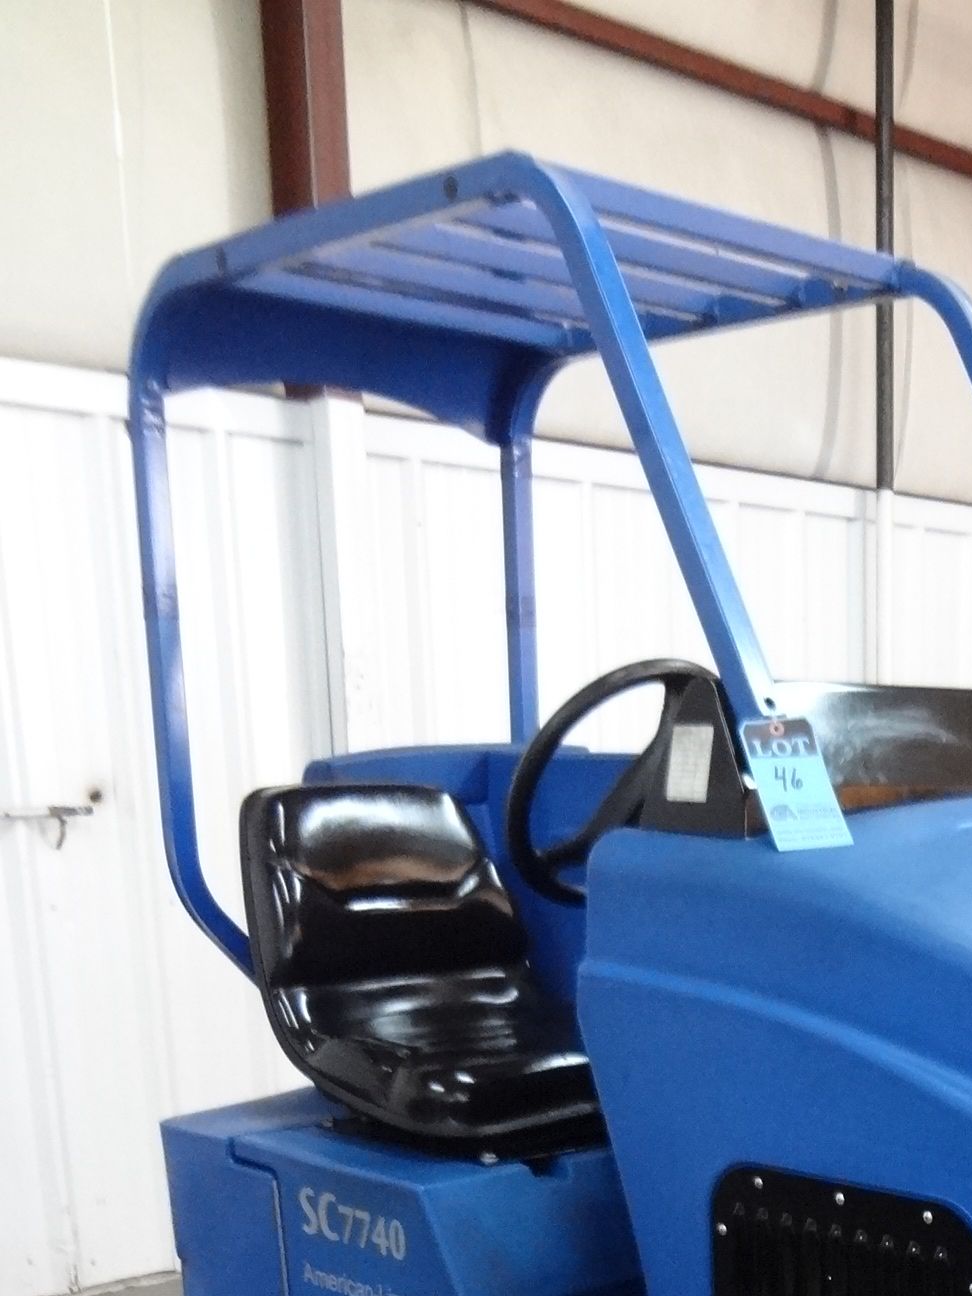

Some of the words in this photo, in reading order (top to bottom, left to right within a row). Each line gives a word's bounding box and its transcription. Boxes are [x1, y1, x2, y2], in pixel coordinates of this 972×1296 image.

[752, 736, 810, 757] LOT
[774, 765, 804, 792] 46
[298, 1186, 407, 1261] SC7740
